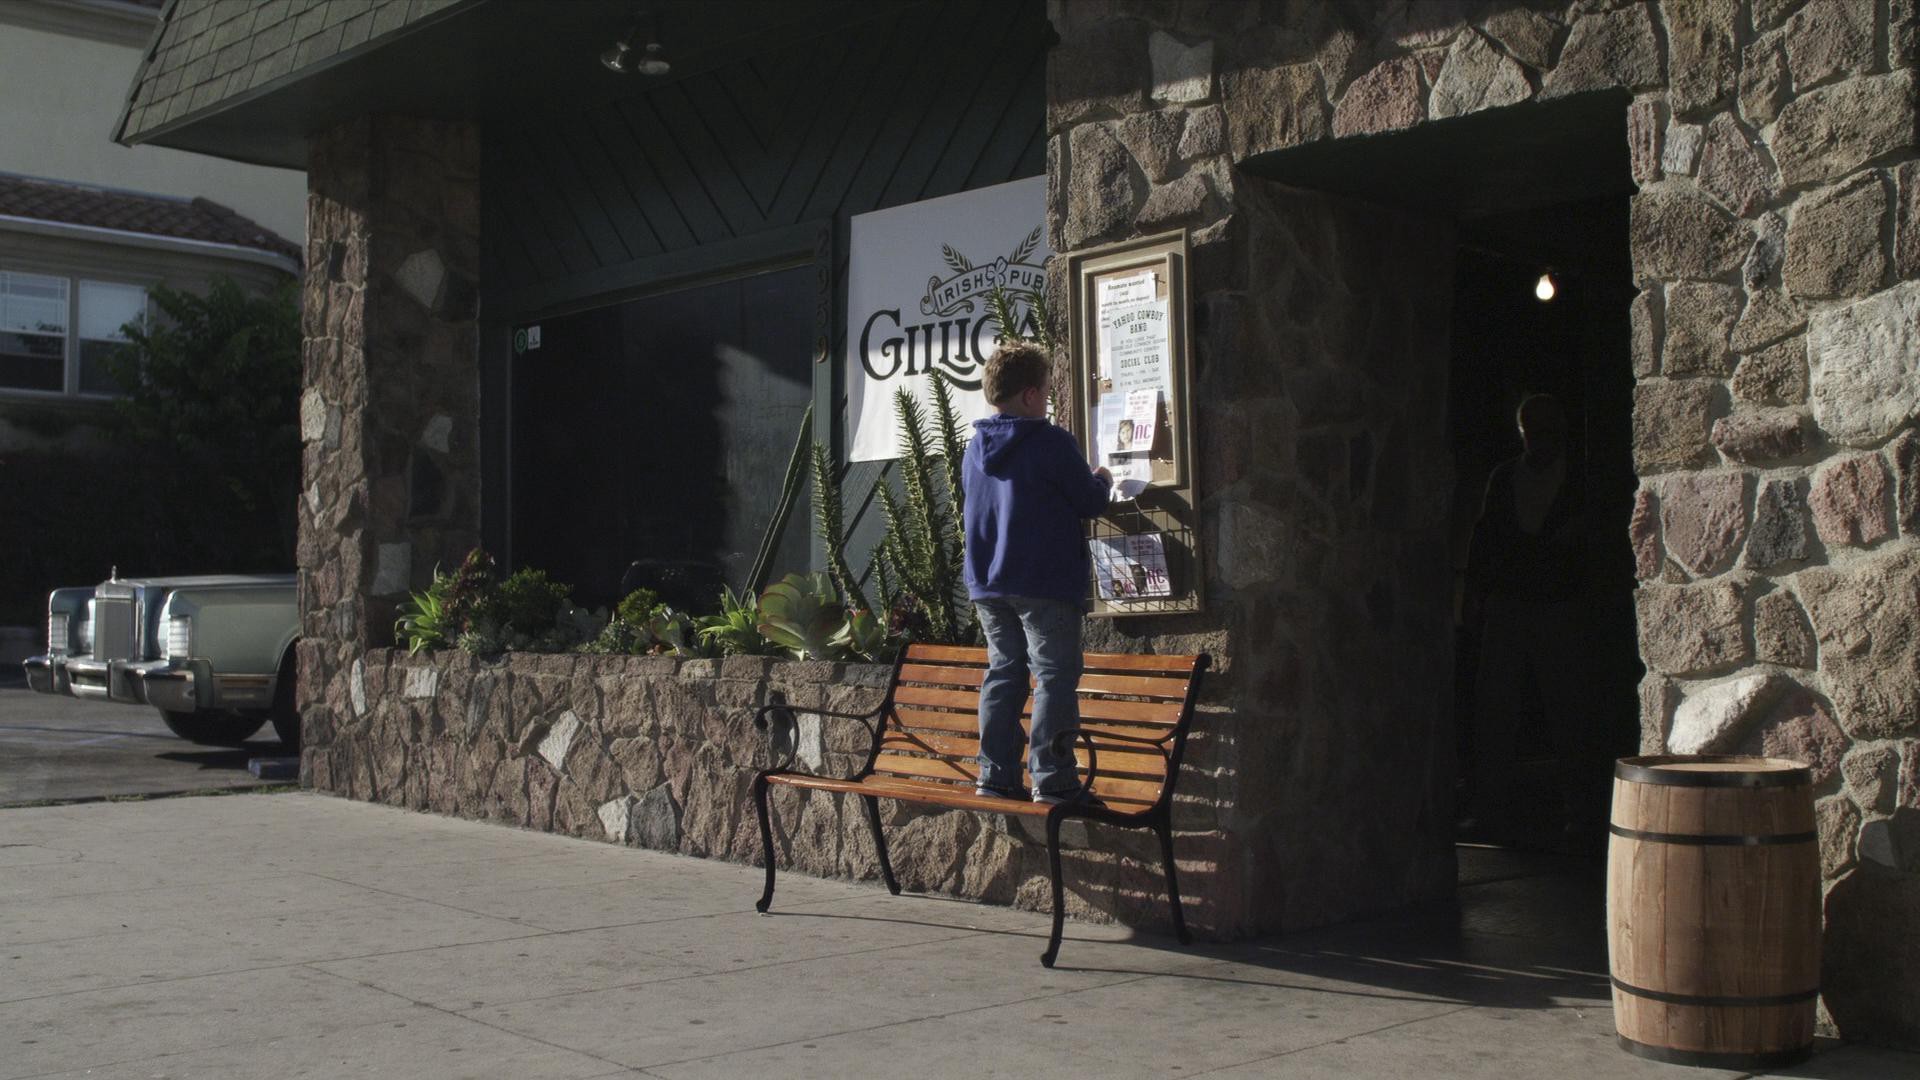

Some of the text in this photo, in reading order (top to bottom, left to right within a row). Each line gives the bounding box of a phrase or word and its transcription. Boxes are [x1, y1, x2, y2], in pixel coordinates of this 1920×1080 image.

[937, 270, 1044, 307] IRISH PUB
[1137, 310, 1164, 321] COWBOY
[1130, 322, 1147, 334] BAND
[1120, 354, 1159, 368] SOCIAL CLUB
